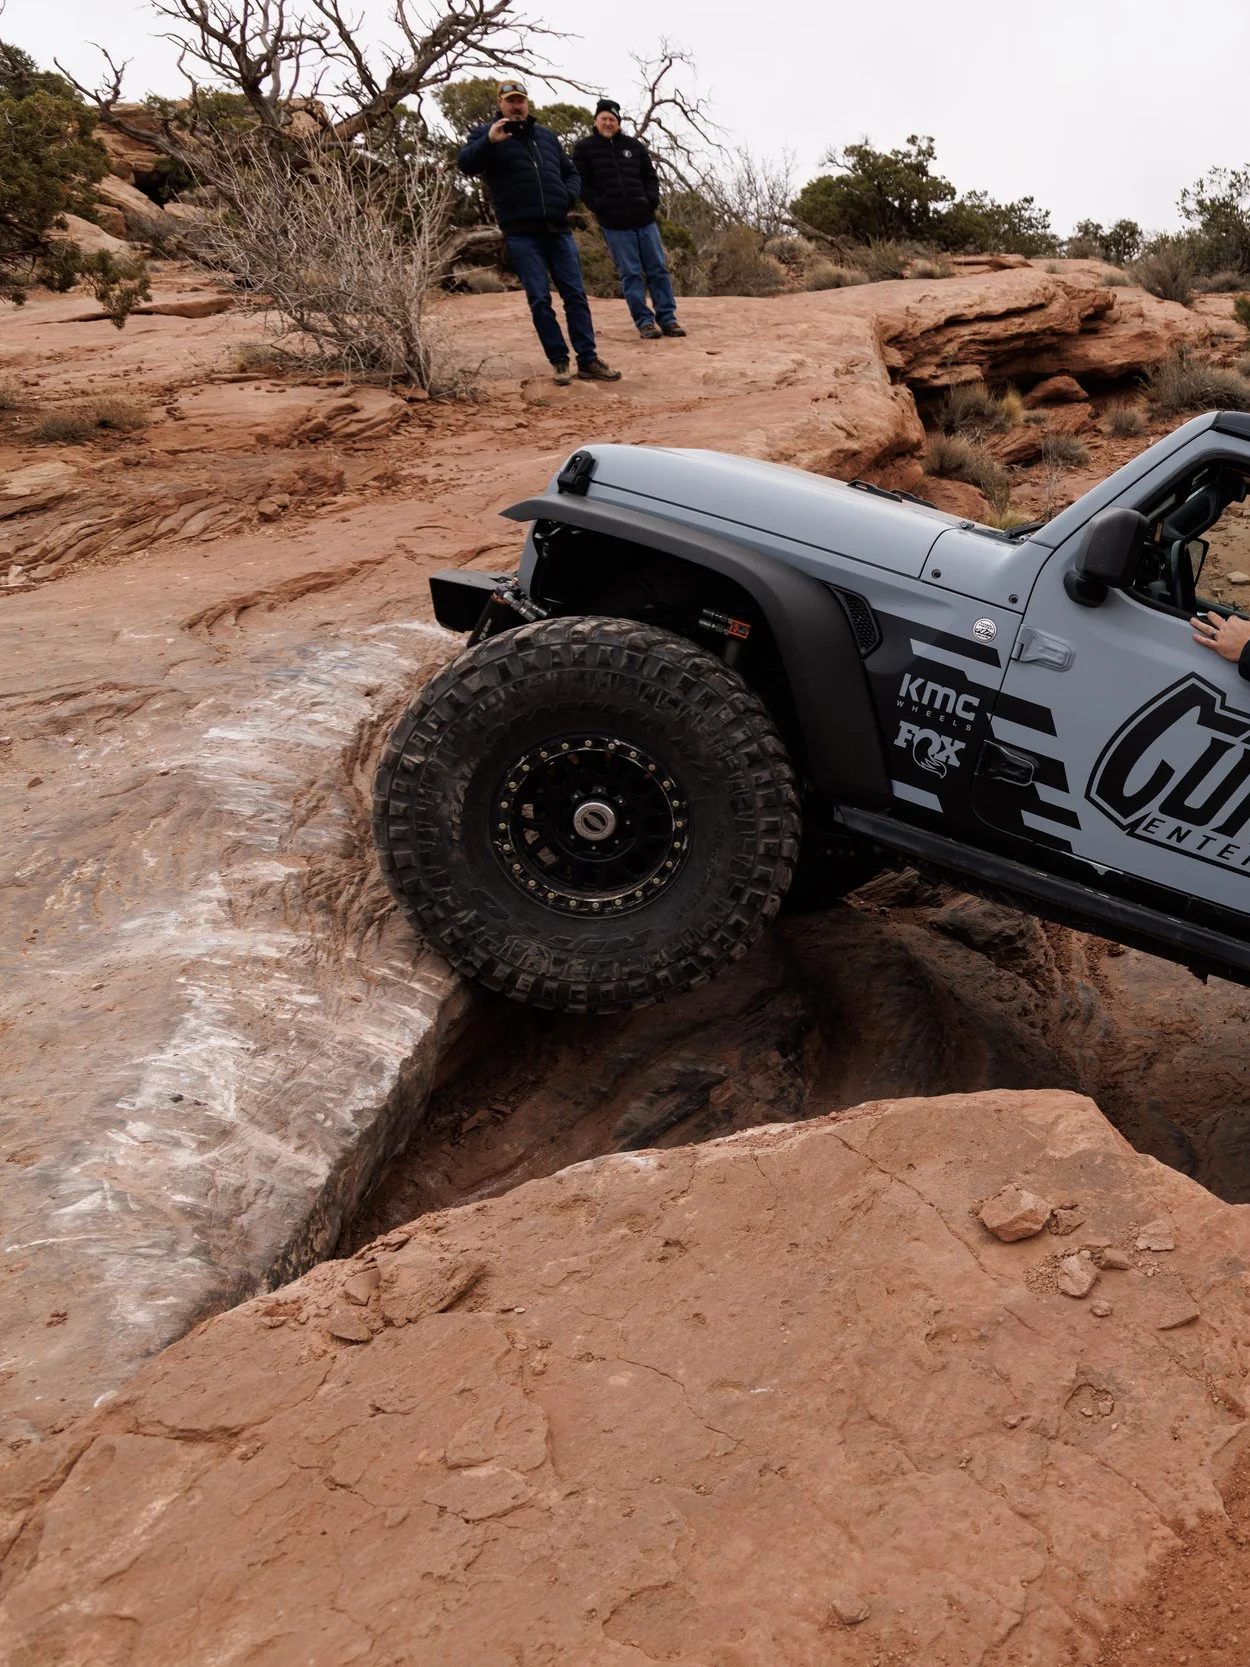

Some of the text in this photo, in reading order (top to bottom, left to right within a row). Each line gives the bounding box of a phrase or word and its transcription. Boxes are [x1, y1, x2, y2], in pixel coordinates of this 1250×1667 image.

[896, 699, 971, 731] WHEELS
[898, 673, 981, 722] KMC
[893, 720, 967, 778] FOX
